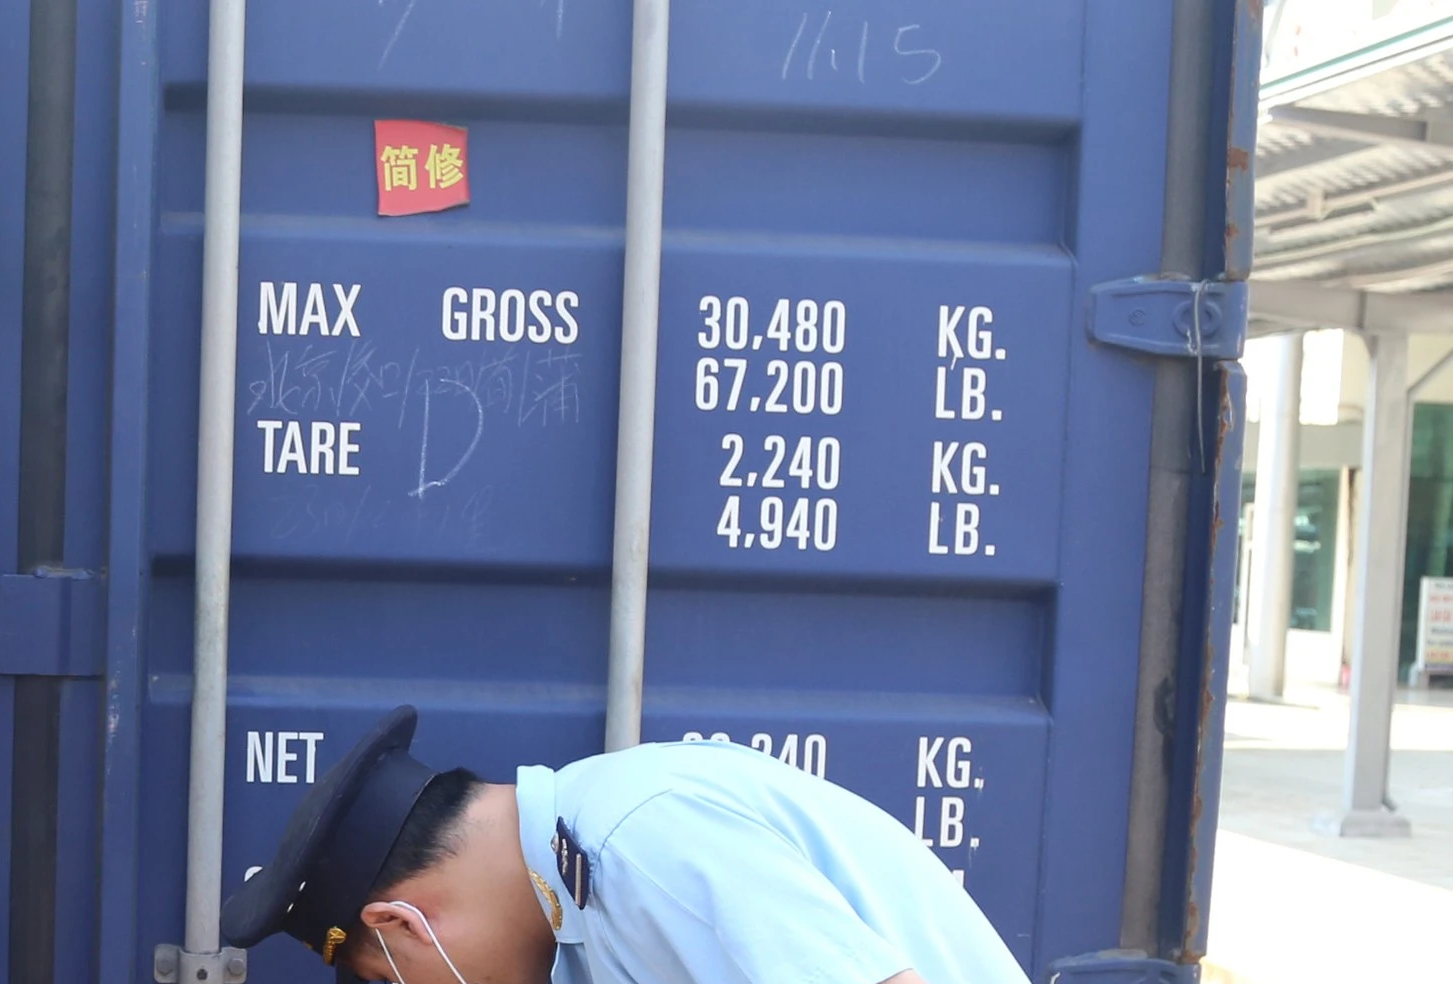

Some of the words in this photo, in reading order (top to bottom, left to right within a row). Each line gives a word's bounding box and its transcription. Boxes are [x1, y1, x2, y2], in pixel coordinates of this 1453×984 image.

[380, 143, 464, 191] 简修
[258, 282, 362, 338] MAX
[442, 286, 580, 345] GROSS
[697, 295, 846, 354] 30,480
[937, 305, 1008, 362] KG.
[695, 358, 844, 416] 67,200
[934, 366, 1003, 421] LB.
[256, 419, 361, 476] TARE
[719, 433, 841, 492] 2,240
[931, 441, 1001, 496] KG.
[716, 496, 838, 552] 4,940
[928, 501, 997, 557] LB.
[246, 731, 324, 784] NET
[916, 736, 985, 789] KG.
[914, 796, 981, 848] LB.
